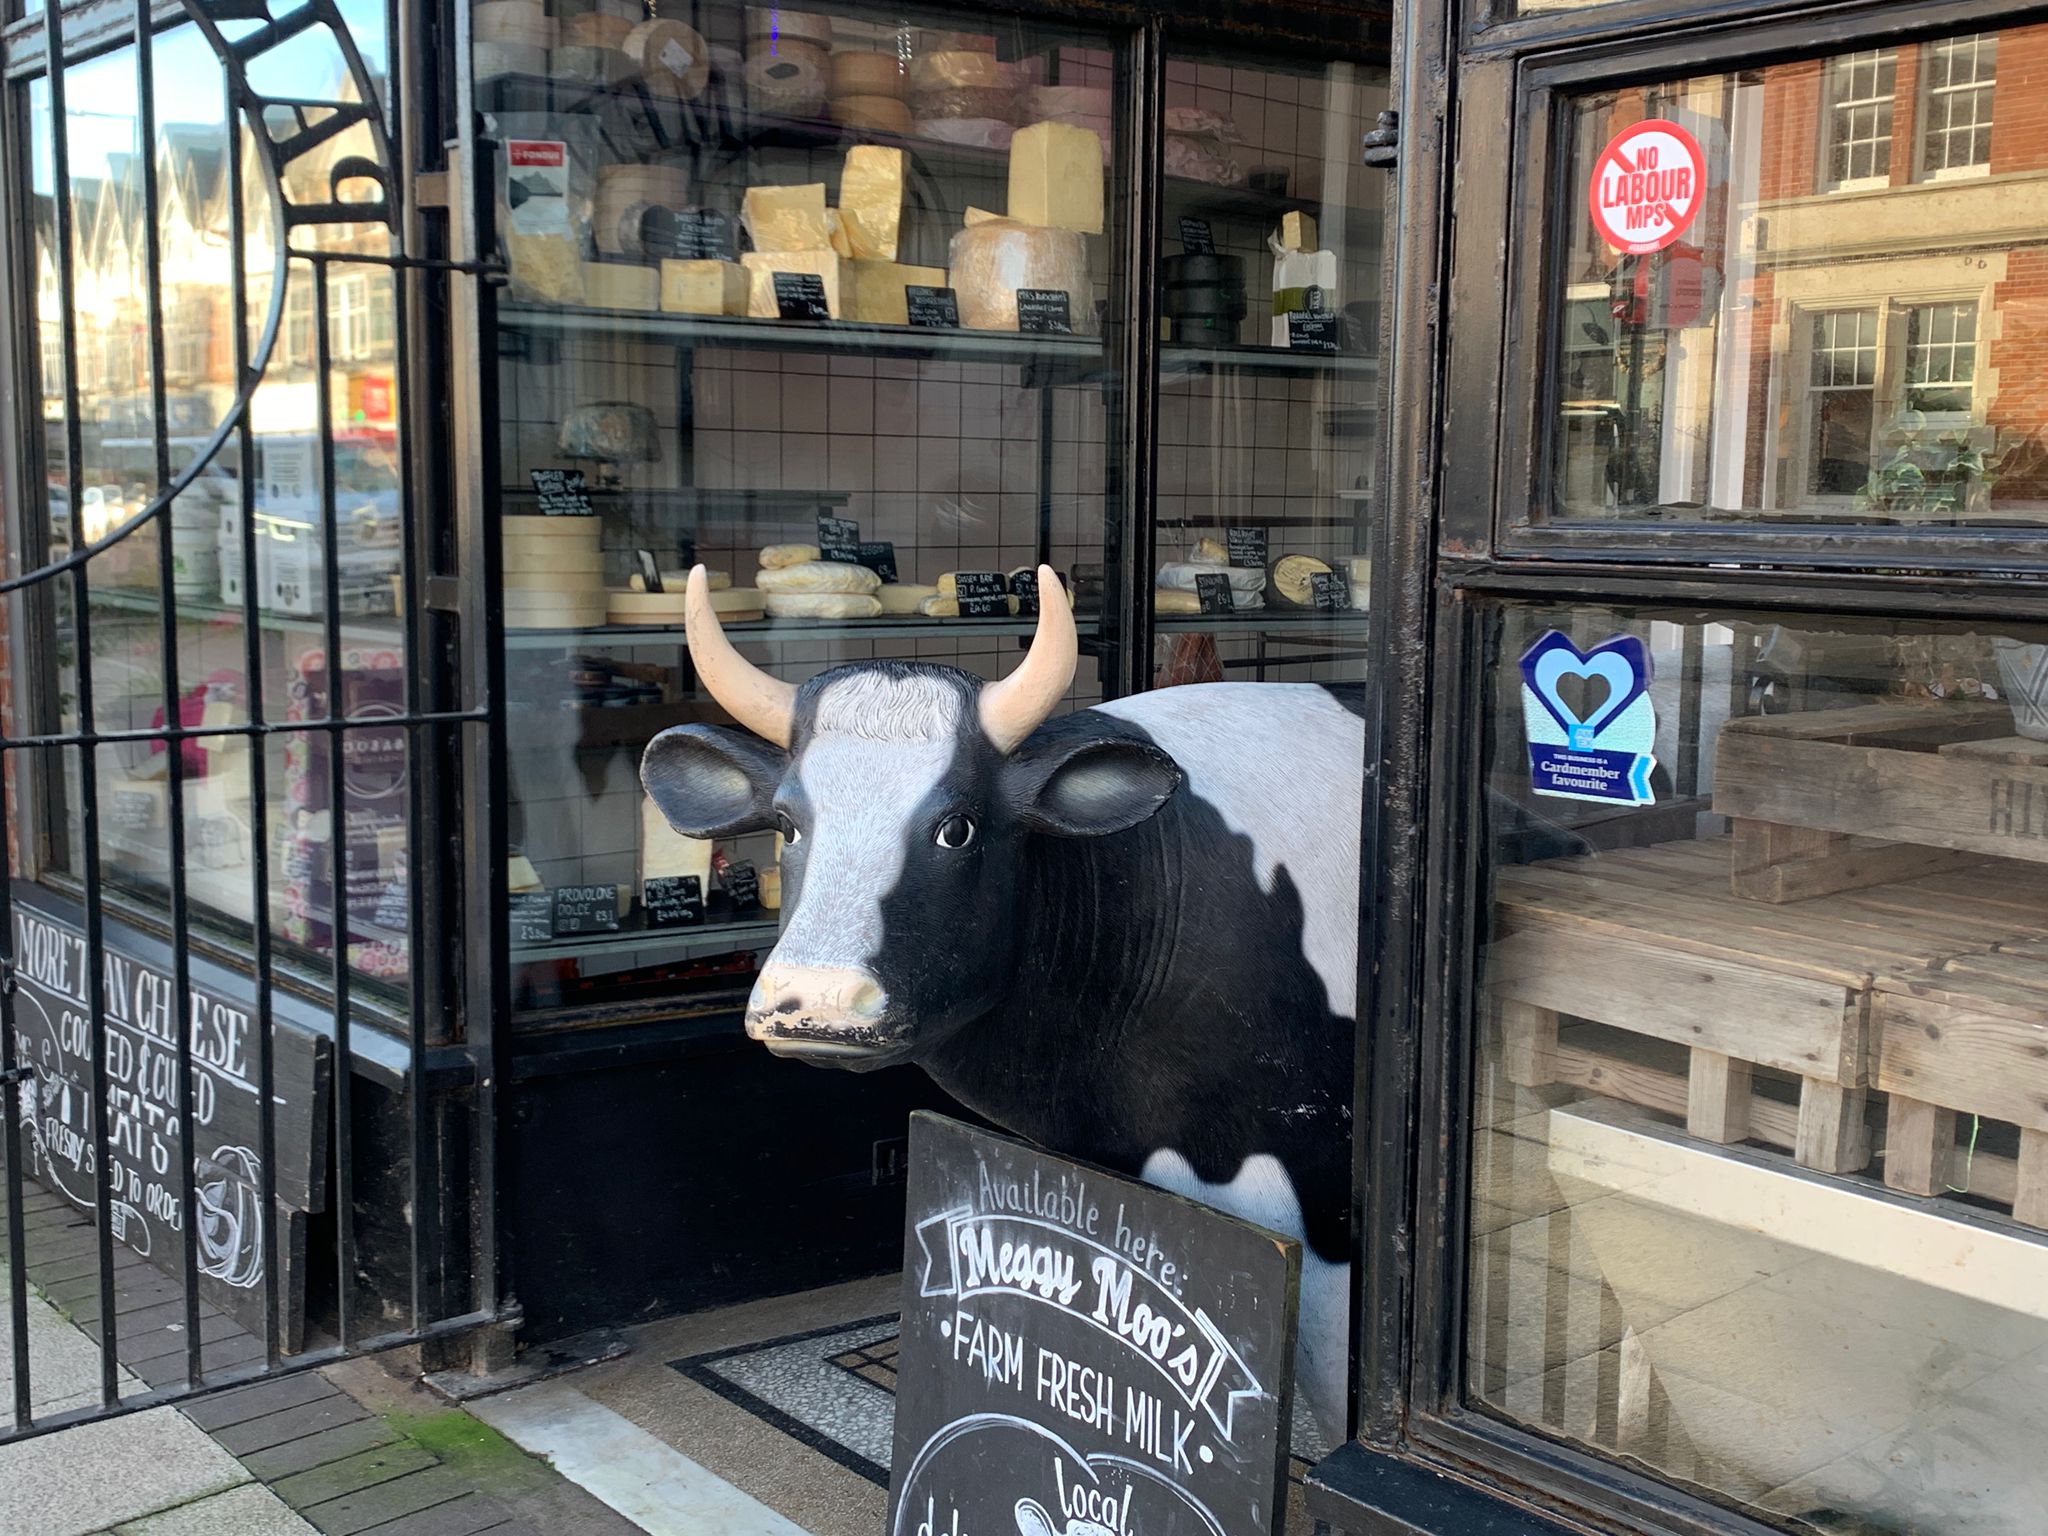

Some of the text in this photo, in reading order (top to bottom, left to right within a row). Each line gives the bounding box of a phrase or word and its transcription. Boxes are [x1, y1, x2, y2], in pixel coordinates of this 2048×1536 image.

[1603, 167, 1691, 209] LABOUR
[1636, 146, 1658, 171] NO
[1541, 760, 1620, 779] Cardmember
[1552, 774, 1608, 790] favourite
[558, 887, 615, 901] PROVOLONE
[17, 913, 72, 994] MORE
[75, 938, 130, 1021] TAN
[136, 969, 249, 1078] CHESE
[979, 1159, 1099, 1235] Available
[959, 1226, 1198, 1387] Meggy Moo's
[953, 1310, 1196, 1476] FARM FRESH MILK
[1054, 1456, 1134, 1536] local
